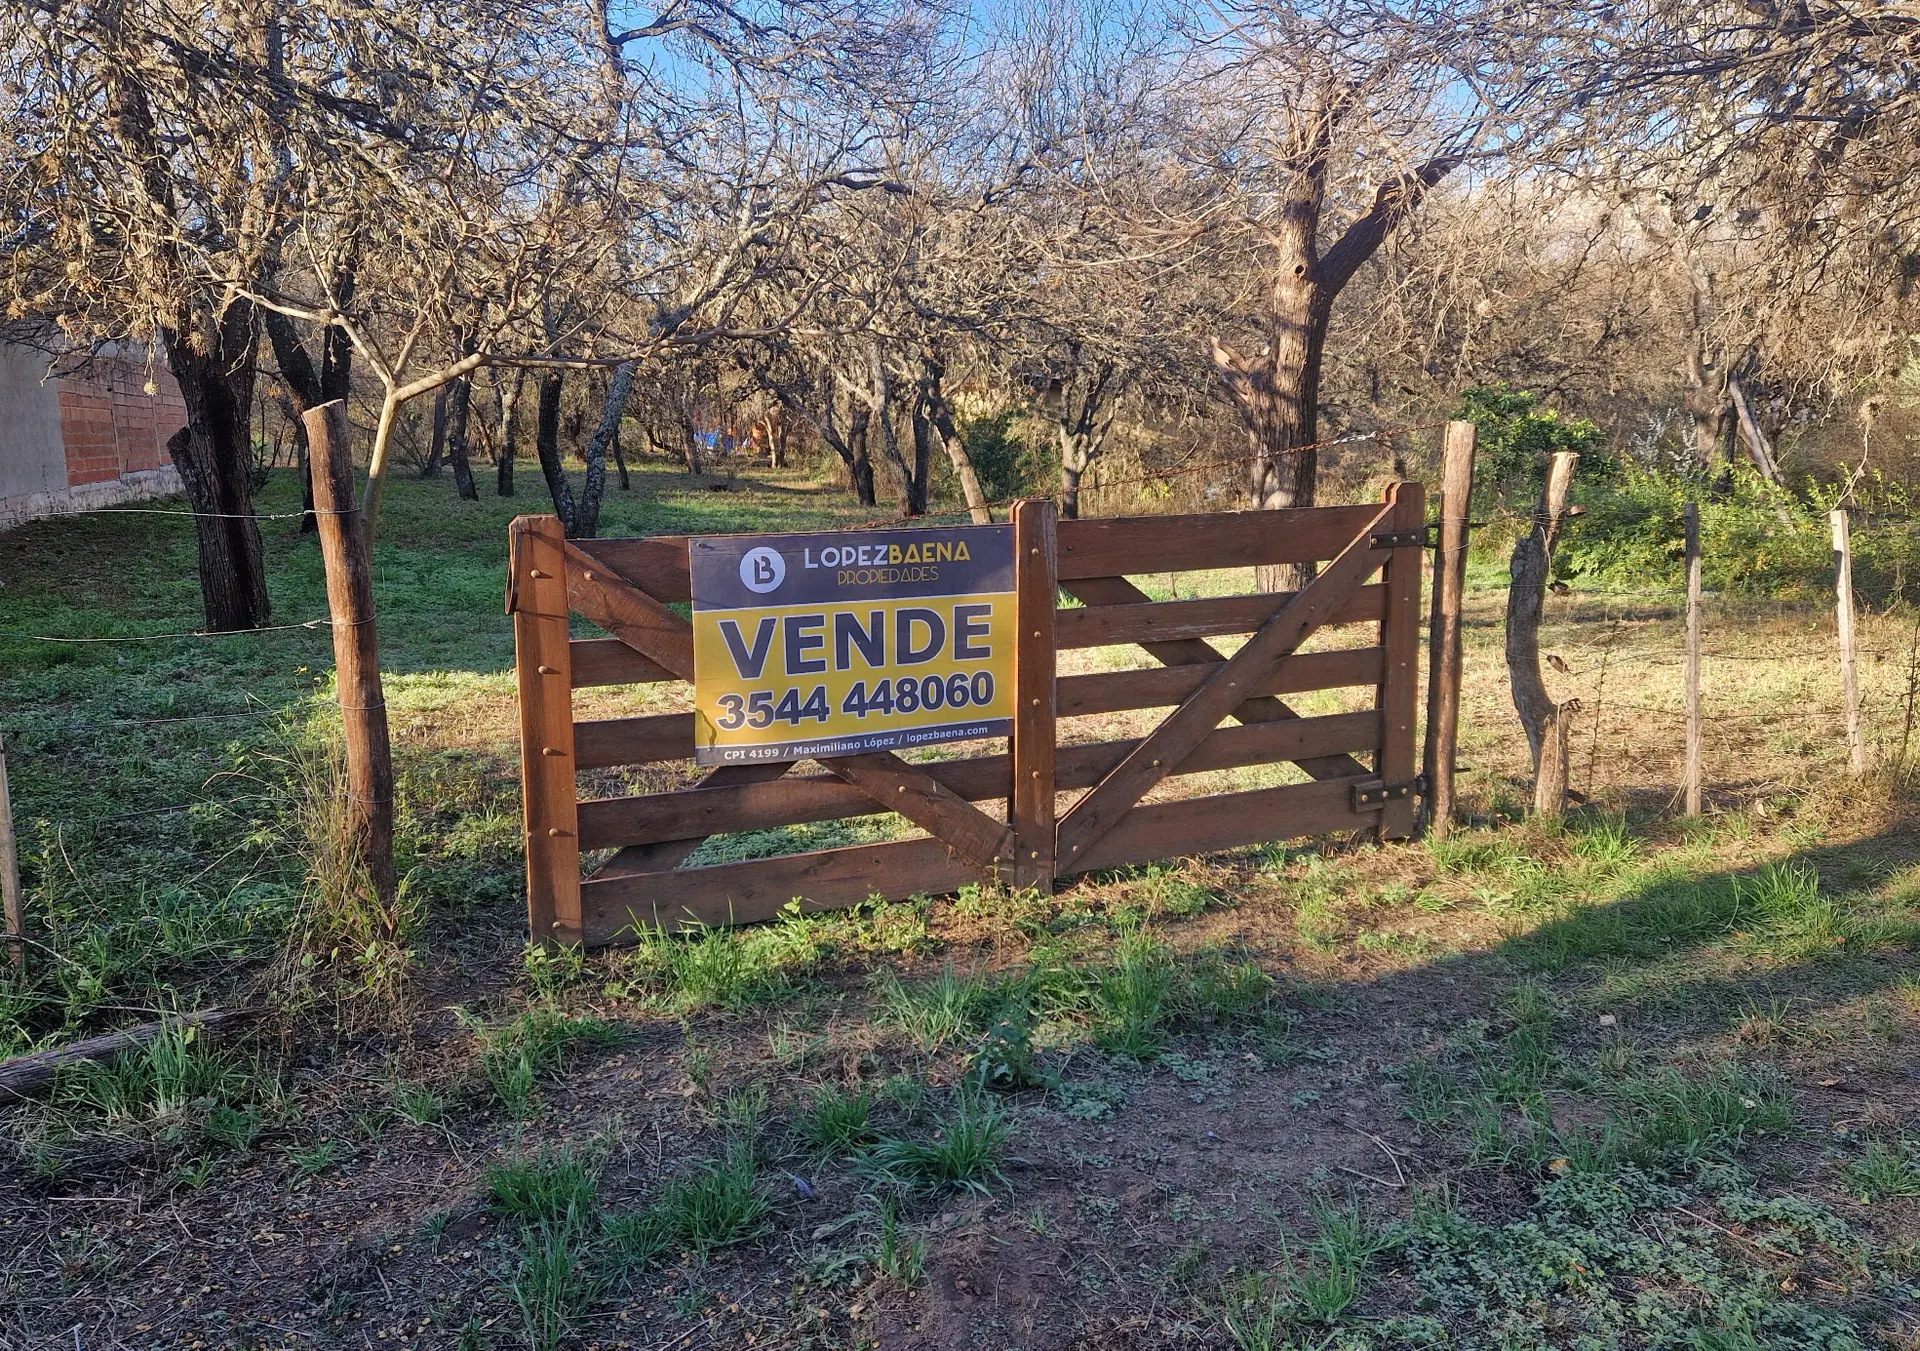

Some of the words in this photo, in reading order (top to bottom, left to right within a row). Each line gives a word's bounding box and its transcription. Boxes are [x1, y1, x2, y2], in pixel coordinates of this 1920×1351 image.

[804, 541, 970, 569] LOPEZBAENA
[838, 566, 939, 586] PROPIEDADES
[717, 603, 993, 680] VENDE
[716, 684, 830, 731] 3544
[842, 670, 995, 719] 448060
[724, 749, 746, 760] CPI
[749, 747, 779, 759] 4199
[783, 746, 789, 758] /
[793, 740, 861, 755] Maximiliano
[863, 735, 895, 751] López
[898, 735, 904, 746] /
[907, 726, 988, 745] lopezbaena.com
